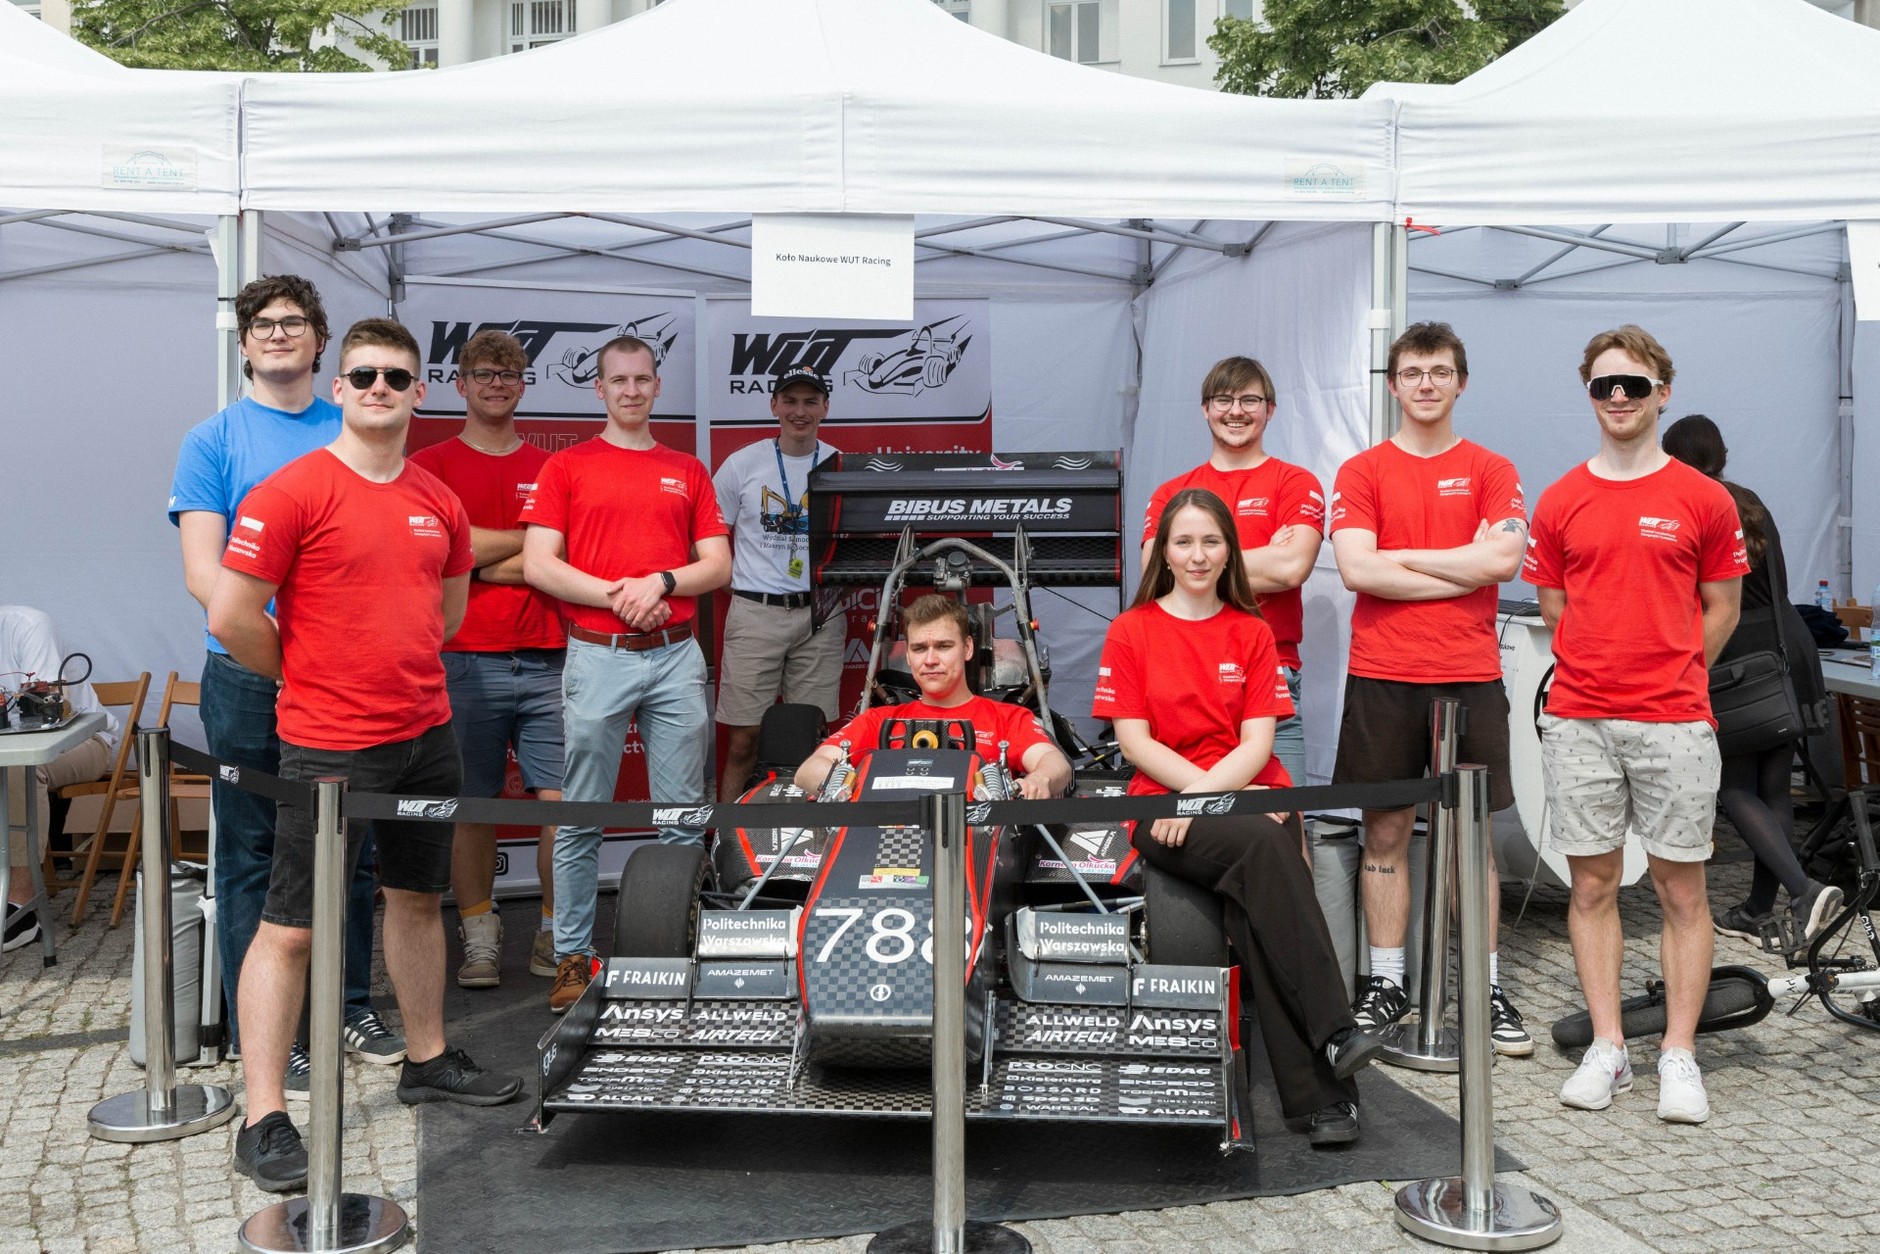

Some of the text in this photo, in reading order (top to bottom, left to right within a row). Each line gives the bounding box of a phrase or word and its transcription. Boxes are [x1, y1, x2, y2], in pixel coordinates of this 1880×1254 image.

[1293, 178, 1354, 187] RENT A TENT
[775, 253, 891, 267] Koło Naukowe WUT Racing
[888, 498, 1073, 515] BIBUS METALS
[1023, 513, 1071, 521] SUCCESS
[398, 800, 433, 812] WUT
[1177, 797, 1210, 811] WUT
[652, 808, 687, 821] WUT
[1078, 862, 1116, 870] Olkucka
[703, 917, 787, 931] Politechnika
[1040, 921, 1125, 936] Politechnika
[1860, 915, 1876, 941] CULT
[702, 934, 787, 948] Warszawska
[1040, 938, 1126, 953] Warszawska
[622, 970, 686, 986] FRAIKIN
[707, 969, 775, 977] AMAZEMET
[1044, 974, 1115, 983] AMAZEMET
[1150, 978, 1215, 995] FRAIKIN
[600, 1004, 684, 1023] Ansys
[696, 1010, 788, 1021] ALLWELD
[1025, 1015, 1120, 1027] ALLWELD
[1129, 1015, 1217, 1033] Ansys
[594, 1027, 682, 1039] MESCO
[688, 1029, 780, 1041] AIRTECH
[1025, 1030, 1118, 1043] AIRTECH
[1129, 1035, 1217, 1048] MESCO
[624, 1055, 684, 1063] EDAG
[1151, 1066, 1211, 1075] EDAG
[685, 1078, 781, 1086] BOSSARD
[1003, 1084, 1102, 1095] BOSSARD
[599, 1094, 655, 1102] ALCAR
[1152, 1107, 1211, 1116] ALCAR
